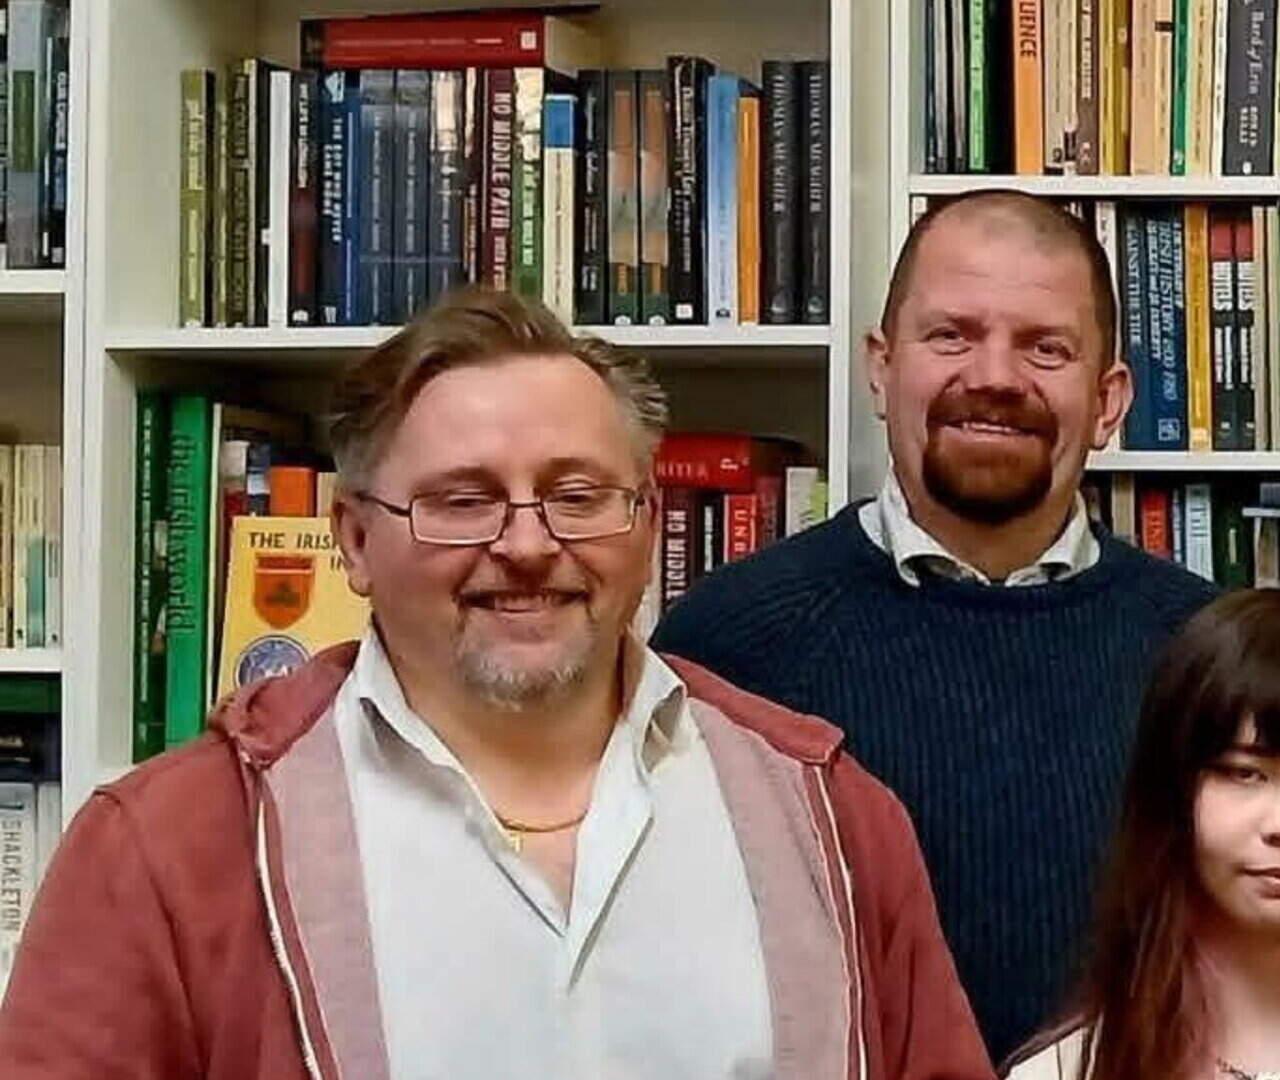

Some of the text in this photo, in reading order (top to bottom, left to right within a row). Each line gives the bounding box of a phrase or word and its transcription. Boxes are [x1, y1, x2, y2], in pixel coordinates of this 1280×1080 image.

[491, 92, 512, 116] NO
[491, 119, 512, 187] MIDDLE
[491, 187, 512, 230] PATH
[250, 532, 286, 548] THE
[1, 819, 22, 933] SHACKLETON
